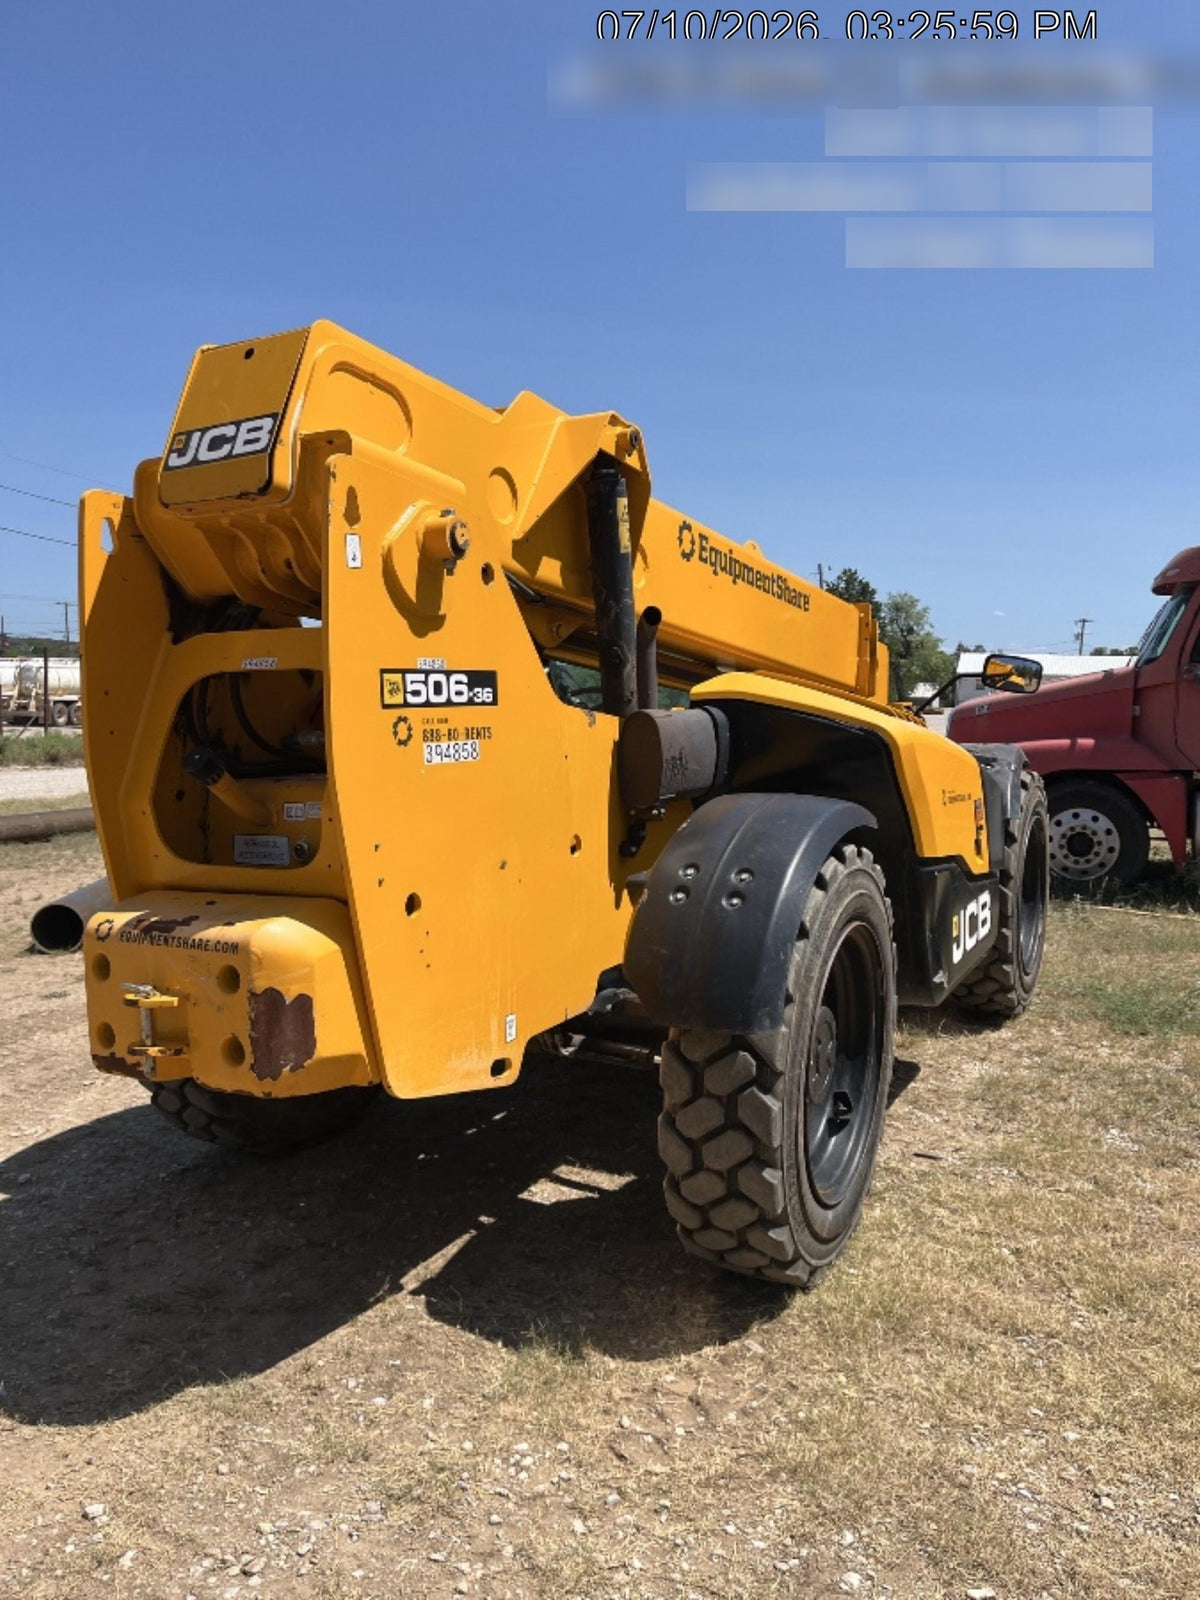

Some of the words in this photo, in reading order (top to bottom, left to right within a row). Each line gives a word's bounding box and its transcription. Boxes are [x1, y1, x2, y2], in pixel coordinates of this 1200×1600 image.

[167, 417, 274, 467] JCB
[698, 532, 810, 612] EquipmentShare
[425, 741, 479, 763] 394858
[119, 930, 239, 955] EQUIPMENTSHARE.COM
[952, 890, 991, 965] JCB
